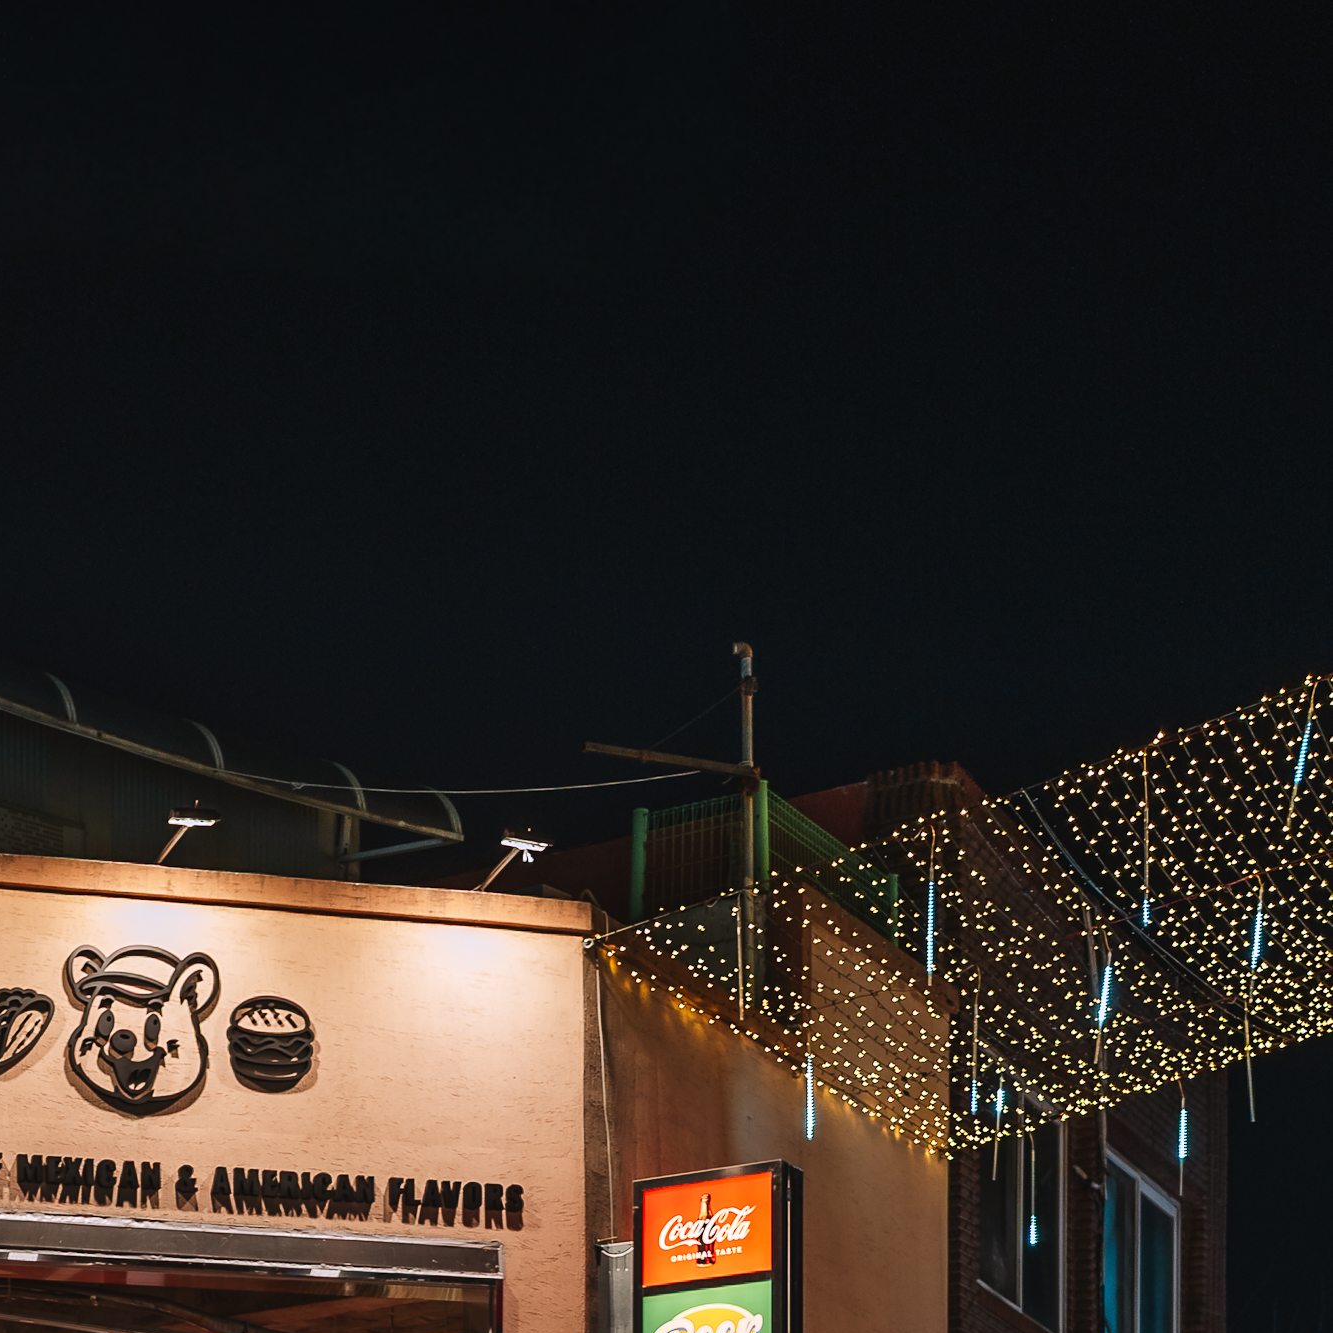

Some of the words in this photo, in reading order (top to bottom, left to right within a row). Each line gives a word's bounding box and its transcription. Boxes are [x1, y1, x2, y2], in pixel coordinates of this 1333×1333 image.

[16, 1153, 161, 1190] MEXICAN
[211, 1166, 374, 1203] AMERICAN
[388, 1177, 524, 1213] FLAVORS
[670, 1250, 712, 1263] ORIGINAL
[715, 1246, 742, 1258] TASTE
